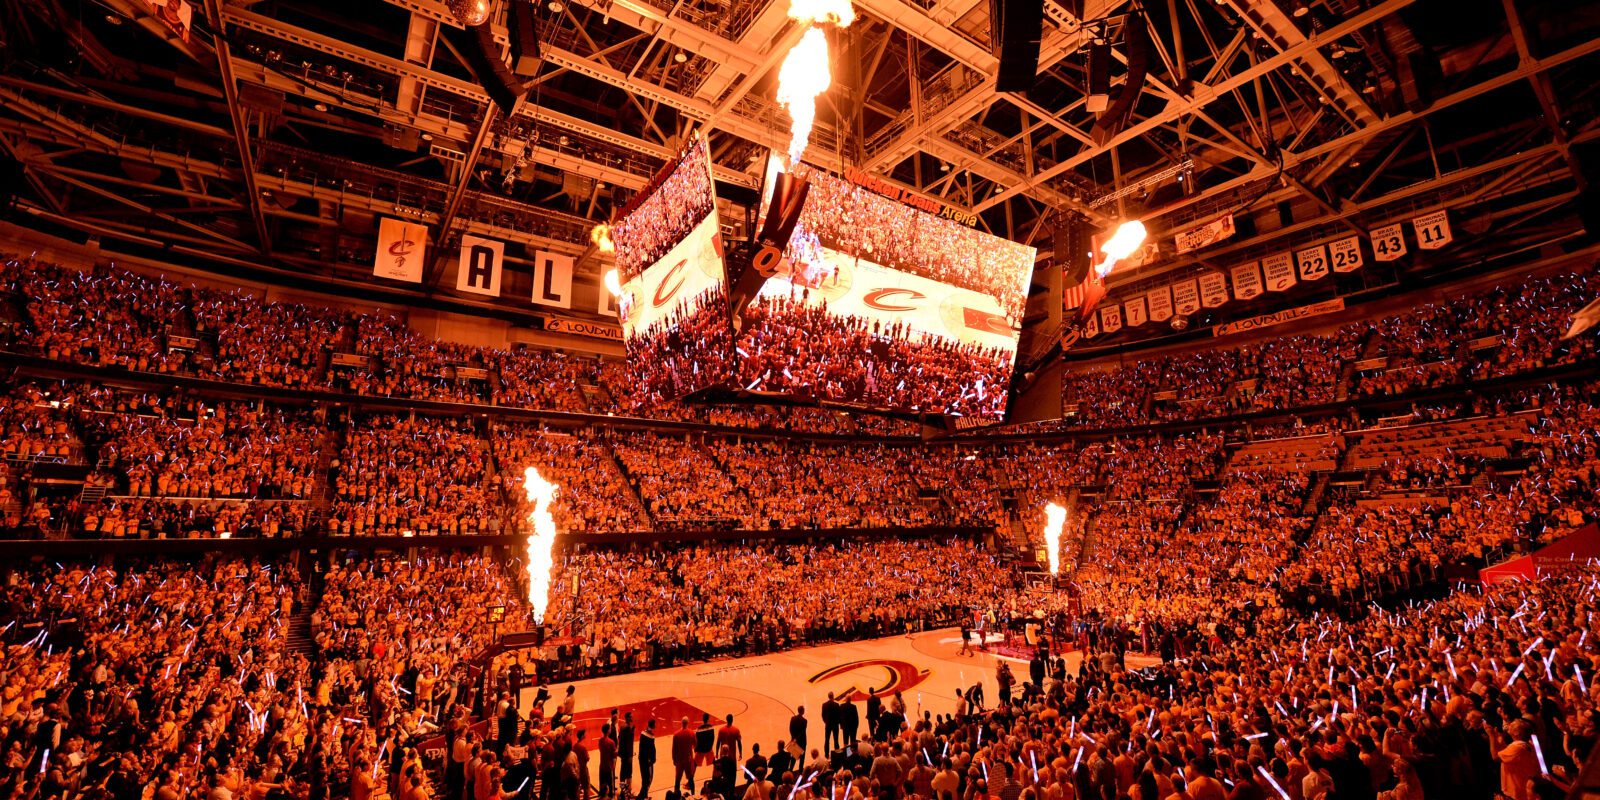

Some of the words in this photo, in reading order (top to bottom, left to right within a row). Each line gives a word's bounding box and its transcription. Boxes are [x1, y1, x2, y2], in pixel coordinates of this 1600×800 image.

[845, 166, 900, 200] Quicken
[902, 190, 941, 214] Loans
[942, 206, 977, 227] Arena
[1422, 225, 1445, 243] 11
[1377, 237, 1402, 254] 43
[753, 245, 781, 278] Q
[1302, 258, 1325, 275] 22
[1335, 248, 1359, 267] 25
[467, 245, 494, 290] A
[543, 259, 560, 302] L
[1104, 314, 1119, 328] 42
[1132, 309, 1139, 321] 7
